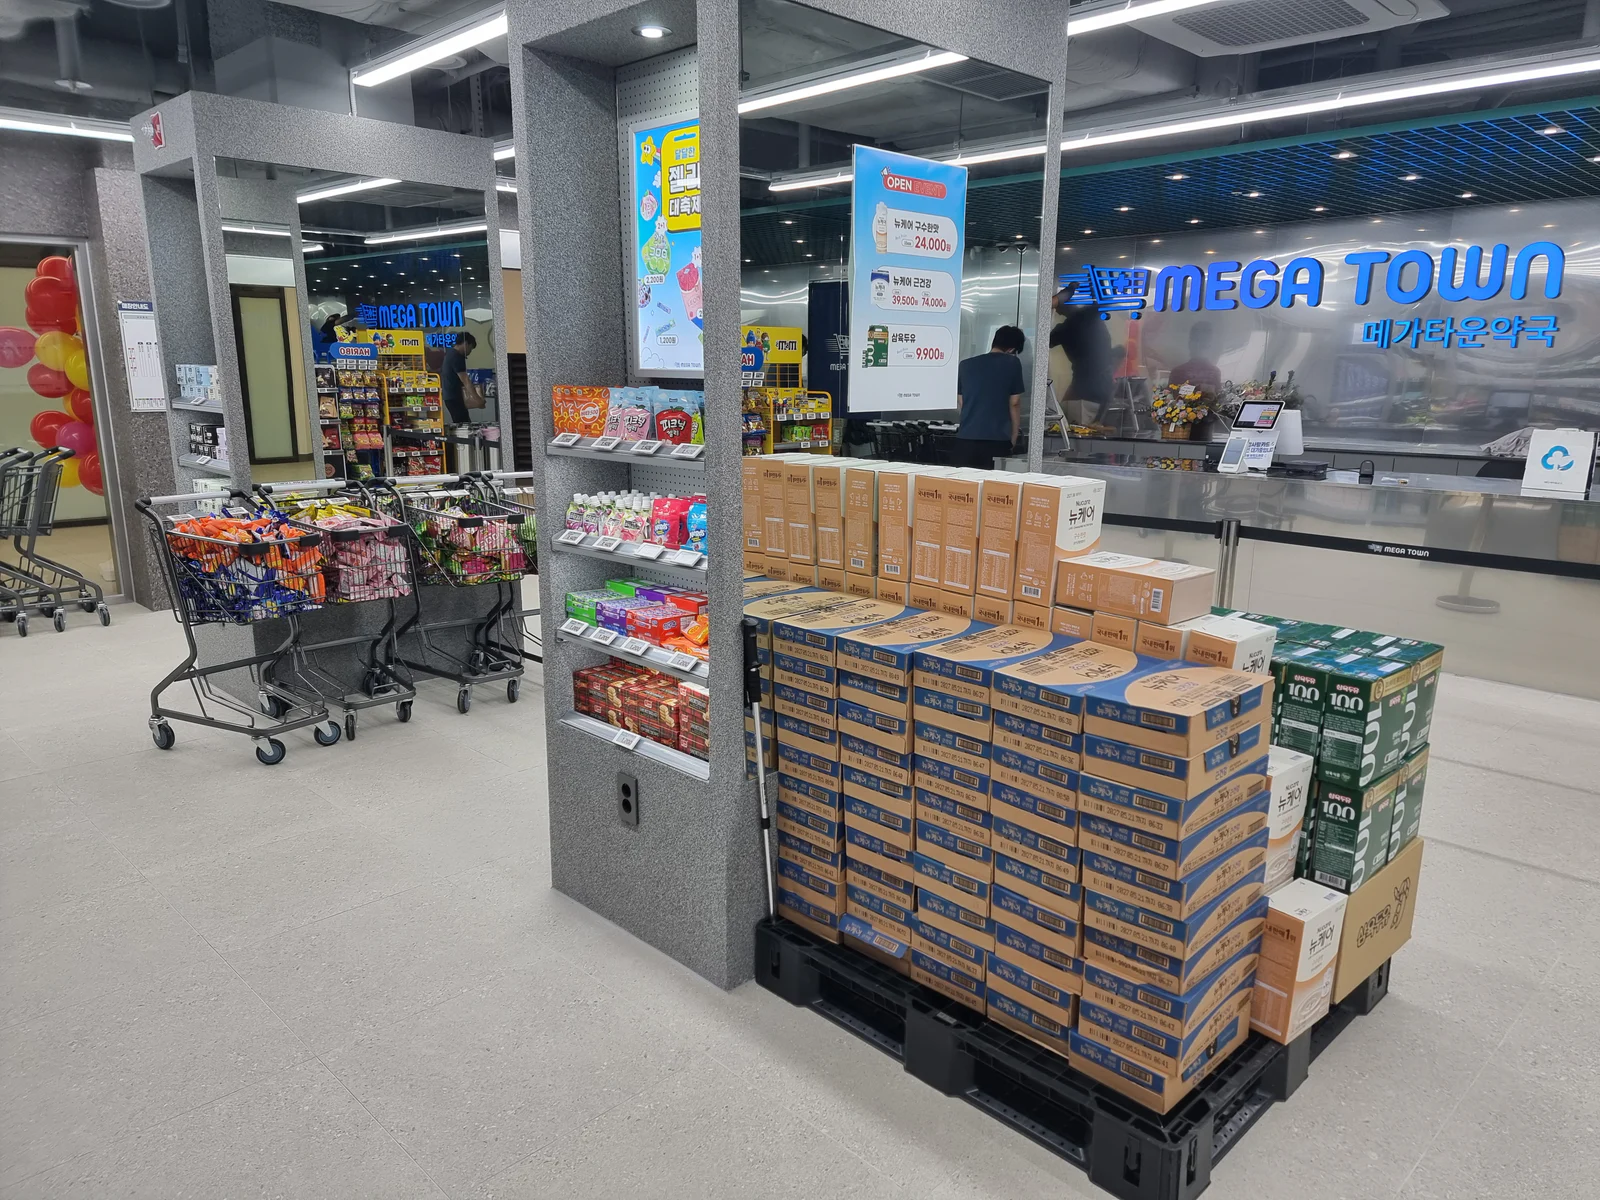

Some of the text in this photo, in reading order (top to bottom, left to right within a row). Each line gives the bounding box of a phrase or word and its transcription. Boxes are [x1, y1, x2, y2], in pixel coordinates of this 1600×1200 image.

[887, 176, 943, 197] OPEN EVENT
[894, 218, 940, 234] 뉴케어 구수한맛
[914, 235, 951, 252] 24,000원
[893, 276, 932, 289] 뉴케어 근건강
[1154, 241, 1565, 312] MEGA TOWN
[378, 300, 463, 329] MEGA TOWN
[892, 333, 916, 344] 삼육두유
[1362, 314, 1560, 348] 메가타운약국
[916, 347, 944, 360] 9,900원
[660, 419, 686, 430] 피크닉
[1069, 505, 1096, 526] 뉴케어
[1384, 546, 1430, 557] MEGA TOWN
[1288, 683, 1320, 701] 100
[1330, 692, 1364, 711] 100
[1278, 786, 1303, 813] 뉴케어
[1322, 800, 1356, 820] 100
[1356, 904, 1391, 948] 삼육두유
[1309, 924, 1335, 956] 뉴케어
